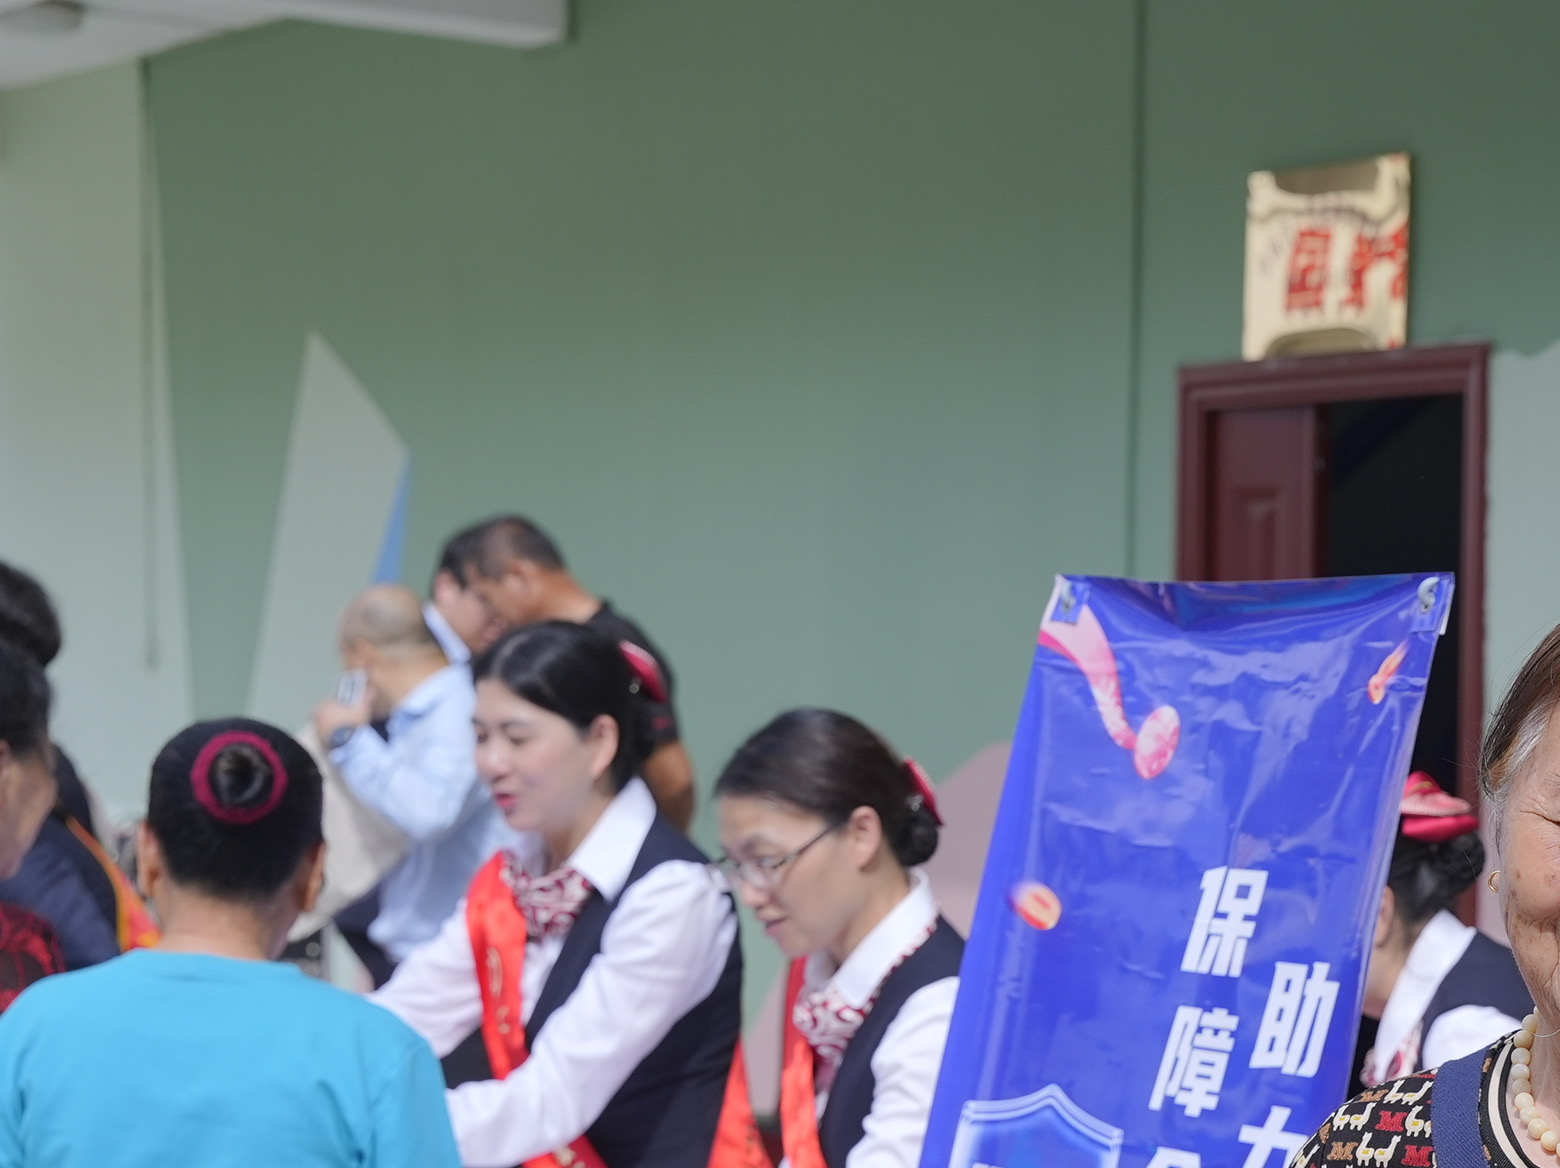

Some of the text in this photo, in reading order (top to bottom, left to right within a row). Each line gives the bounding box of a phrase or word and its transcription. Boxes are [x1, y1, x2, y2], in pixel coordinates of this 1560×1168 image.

[1378, 1112, 1407, 1130] M
[1329, 1143, 1355, 1159] M
[1404, 1146, 1432, 1165] M
